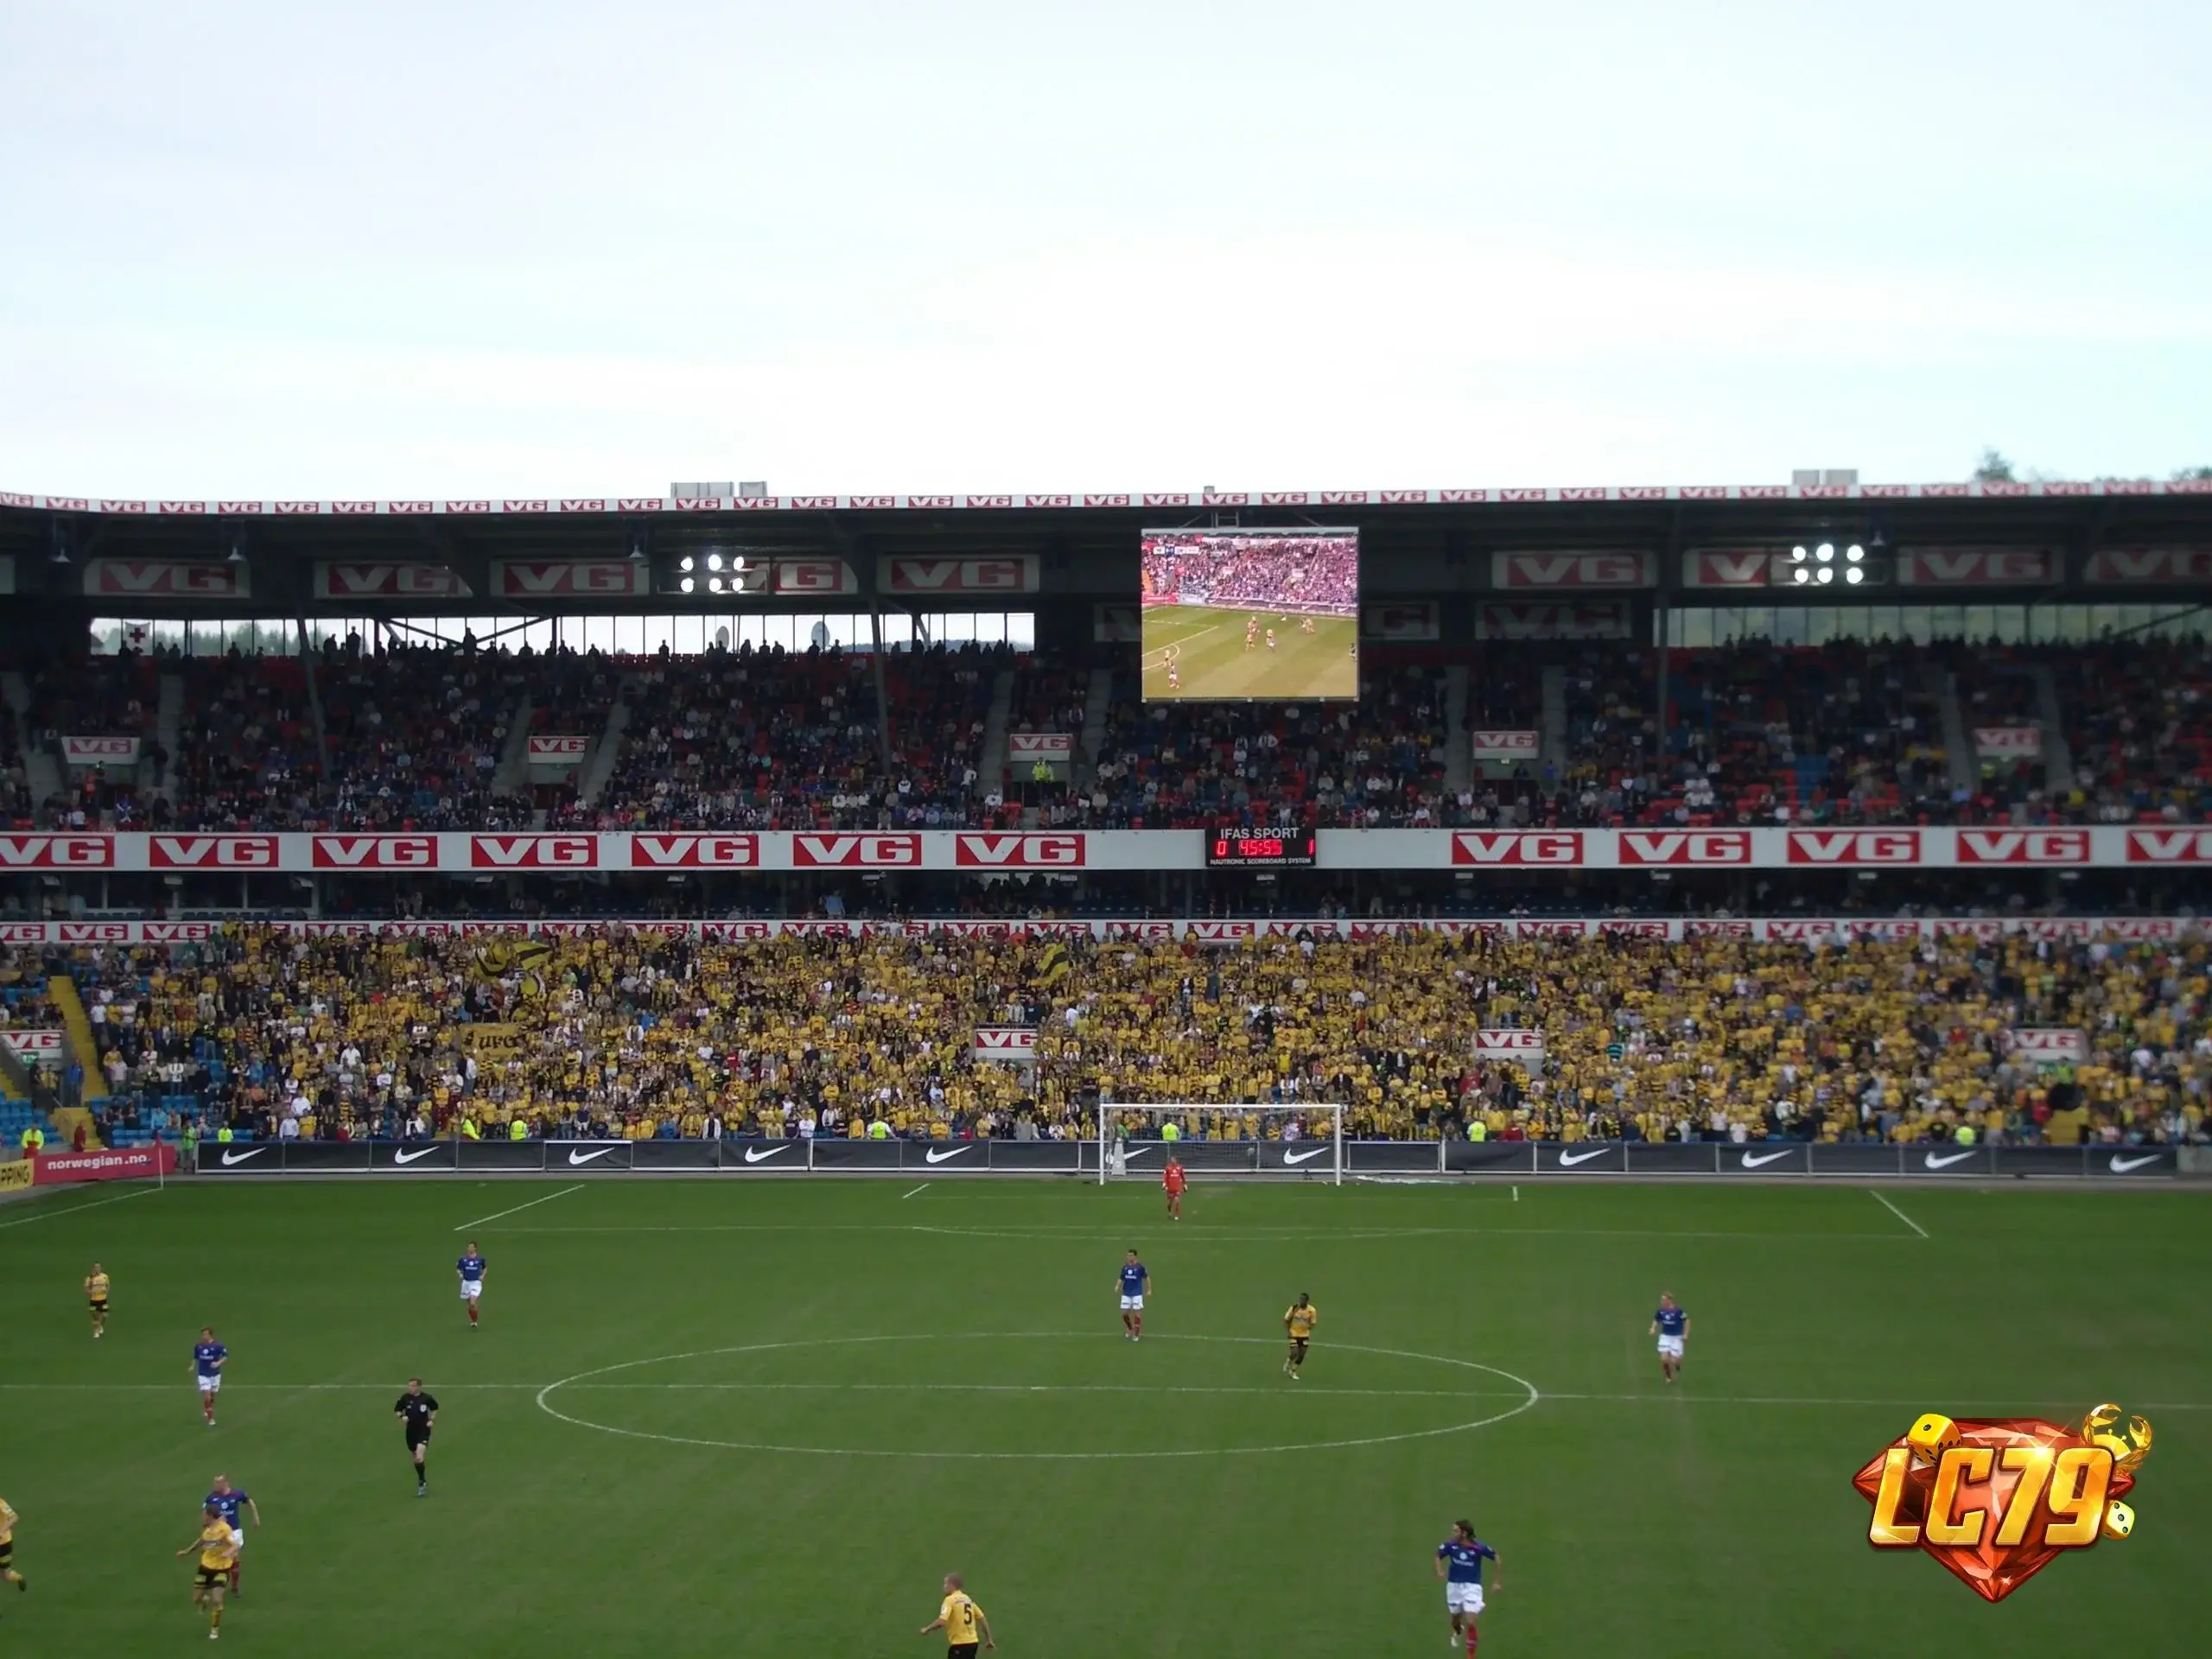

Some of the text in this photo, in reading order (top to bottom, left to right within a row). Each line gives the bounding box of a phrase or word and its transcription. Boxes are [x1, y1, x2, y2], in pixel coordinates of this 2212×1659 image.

[48, 499, 85, 510] VG
[102, 502, 143, 512] VG
[162, 502, 202, 512] VG
[220, 503, 259, 512] VG
[277, 503, 315, 512] VG
[334, 503, 373, 512] VG
[391, 502, 430, 511] VG
[448, 502, 487, 511] VG
[505, 501, 544, 510] VG
[563, 500, 601, 510] VG
[620, 500, 659, 509] VG
[677, 499, 717, 508] VG
[735, 499, 775, 507] VG
[793, 498, 833, 506] VG
[852, 498, 892, 506] VG
[910, 497, 950, 506] VG
[969, 497, 1009, 505] VG
[1027, 496, 1068, 505] VG
[1086, 495, 1127, 505] VG
[1146, 495, 1186, 504] VG
[1205, 494, 1245, 503] VG
[1263, 493, 1304, 503] VG
[1323, 493, 1364, 502] VG
[1382, 492, 1424, 501] VG
[1442, 491, 1484, 500] VG
[1502, 491, 1543, 499] VG
[1562, 490, 1604, 499] VG
[1621, 489, 1663, 499] VG
[1681, 488, 1723, 498] VG
[1741, 487, 1784, 497] VG
[896, 562, 1020, 588] VG
[1513, 556, 1640, 582] VG
[1922, 554, 2042, 580] VG
[103, 564, 228, 591] VG
[334, 565, 450, 591] VG
[508, 564, 627, 590] VG
[73, 740, 128, 752] VG
[533, 739, 584, 751] VG
[1013, 737, 1068, 749] VG
[1478, 735, 1532, 747] VG
[1221, 828, 1299, 839] IFAS SPORT
[0, 836, 1076, 864] VG VG VG VG VG VG VG
[1217, 841, 1226, 855] 0
[1457, 834, 2212, 861] VG VG VG VG V
[63, 925, 124, 940] VG
[145, 925, 206, 939] VG
[1192, 925, 1249, 939] VG
[3, 1033, 60, 1047] VG
[978, 1033, 1037, 1046] VG
[1479, 1033, 1541, 1046] VG
[963, 1603, 972, 1624] 5
